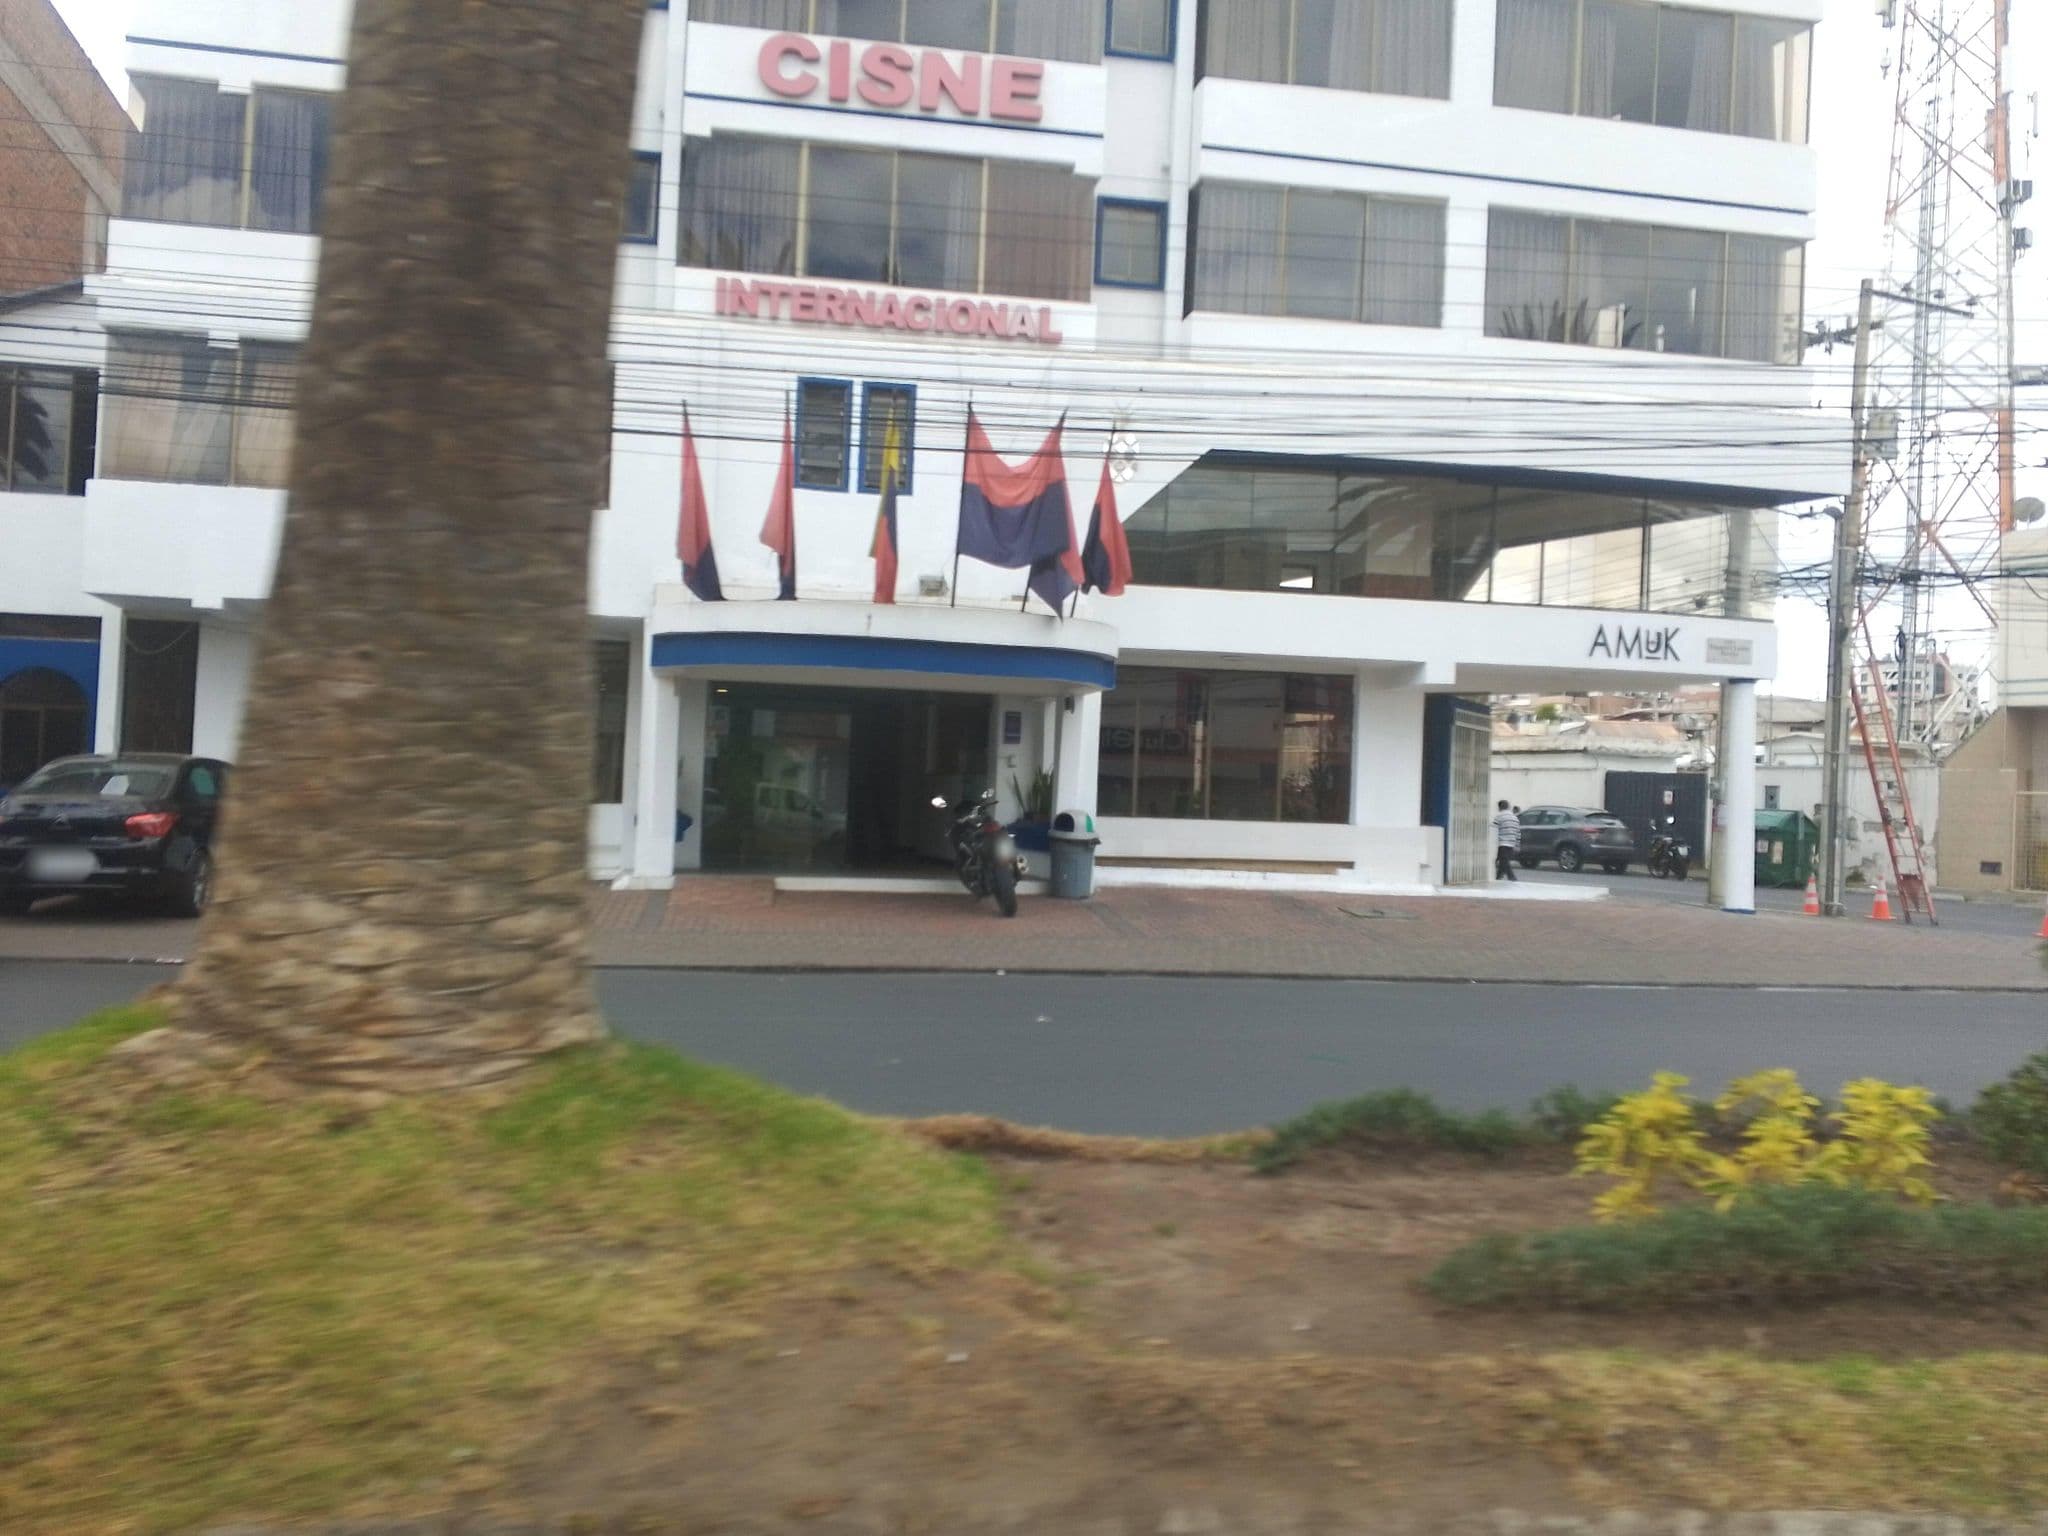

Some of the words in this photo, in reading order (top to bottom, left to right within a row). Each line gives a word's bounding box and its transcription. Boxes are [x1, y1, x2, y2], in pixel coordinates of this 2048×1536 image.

[758, 32, 1044, 122] CISNE
[715, 277, 1063, 344] INTERNACIONAL
[1588, 623, 1681, 662] AMUK
